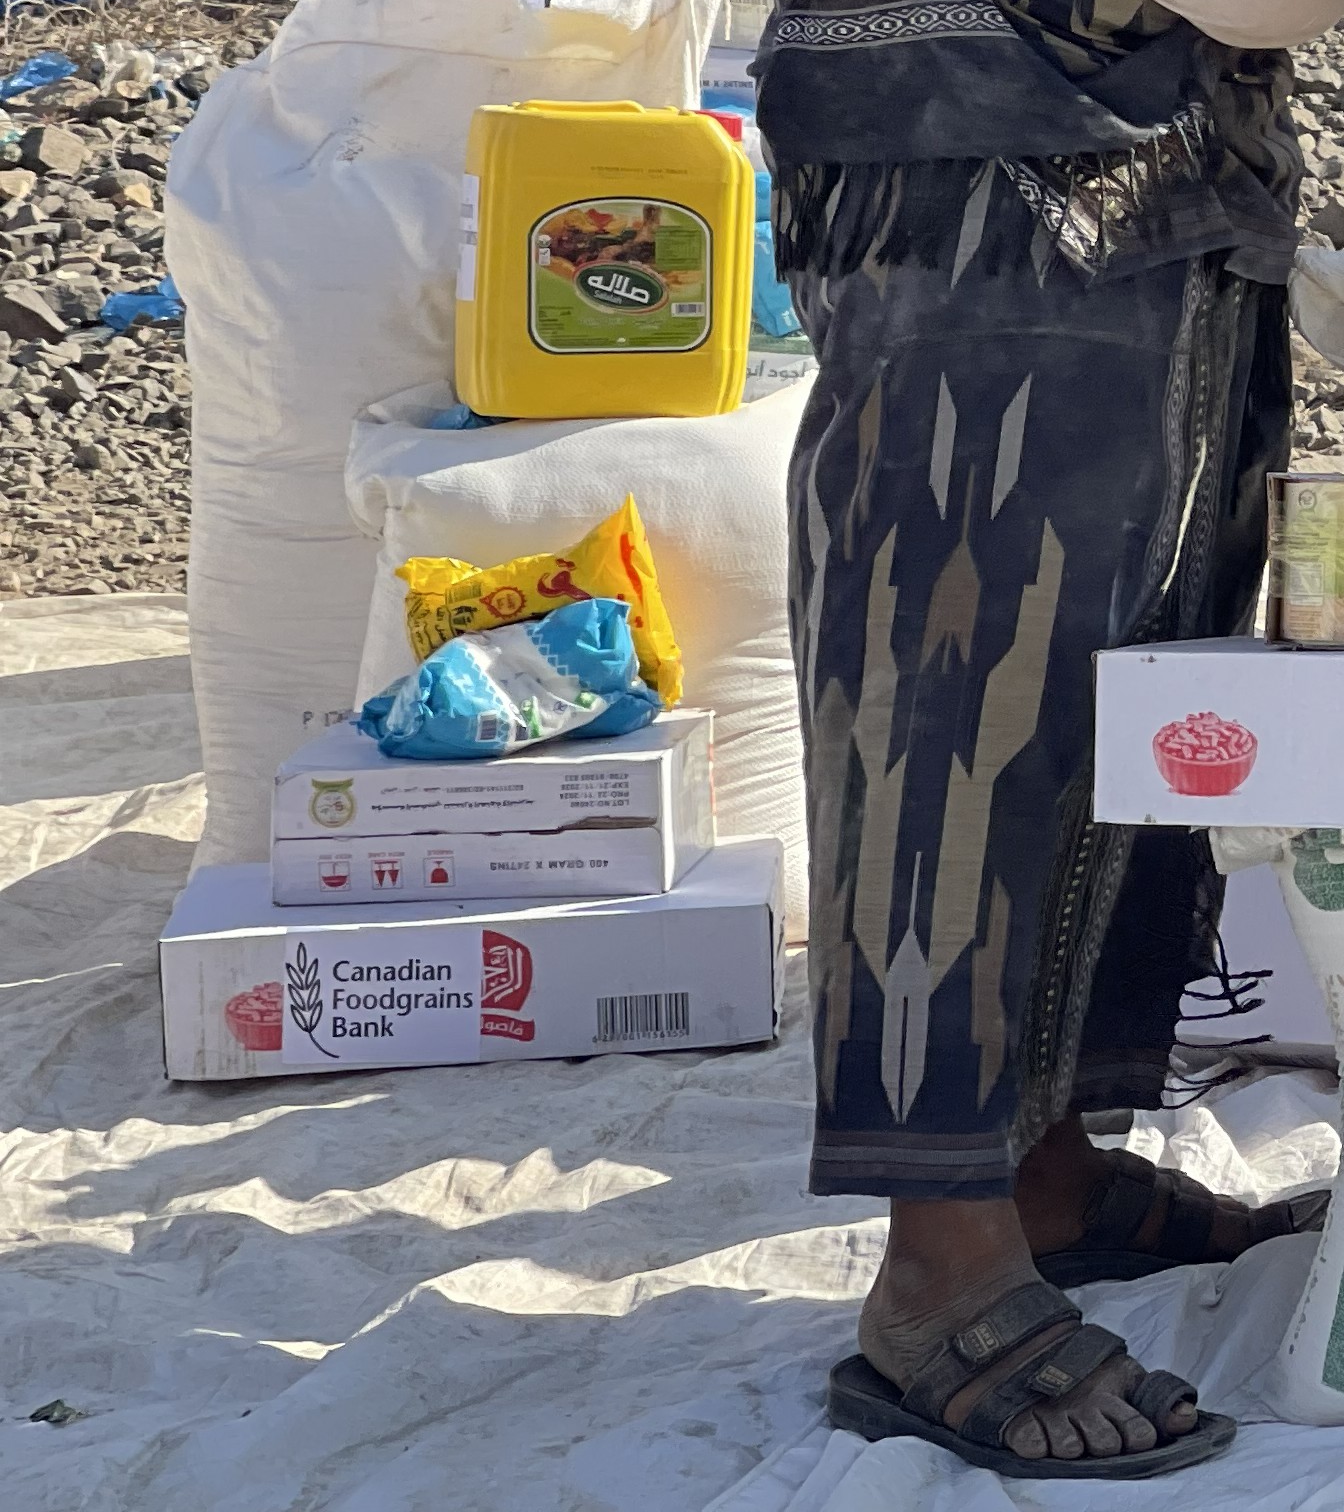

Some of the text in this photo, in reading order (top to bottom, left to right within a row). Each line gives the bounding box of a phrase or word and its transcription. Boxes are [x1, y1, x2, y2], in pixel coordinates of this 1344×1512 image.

[332, 959, 452, 982] Canadian
[332, 987, 473, 1016] Foodgrains
[332, 1016, 394, 1038] Bank
